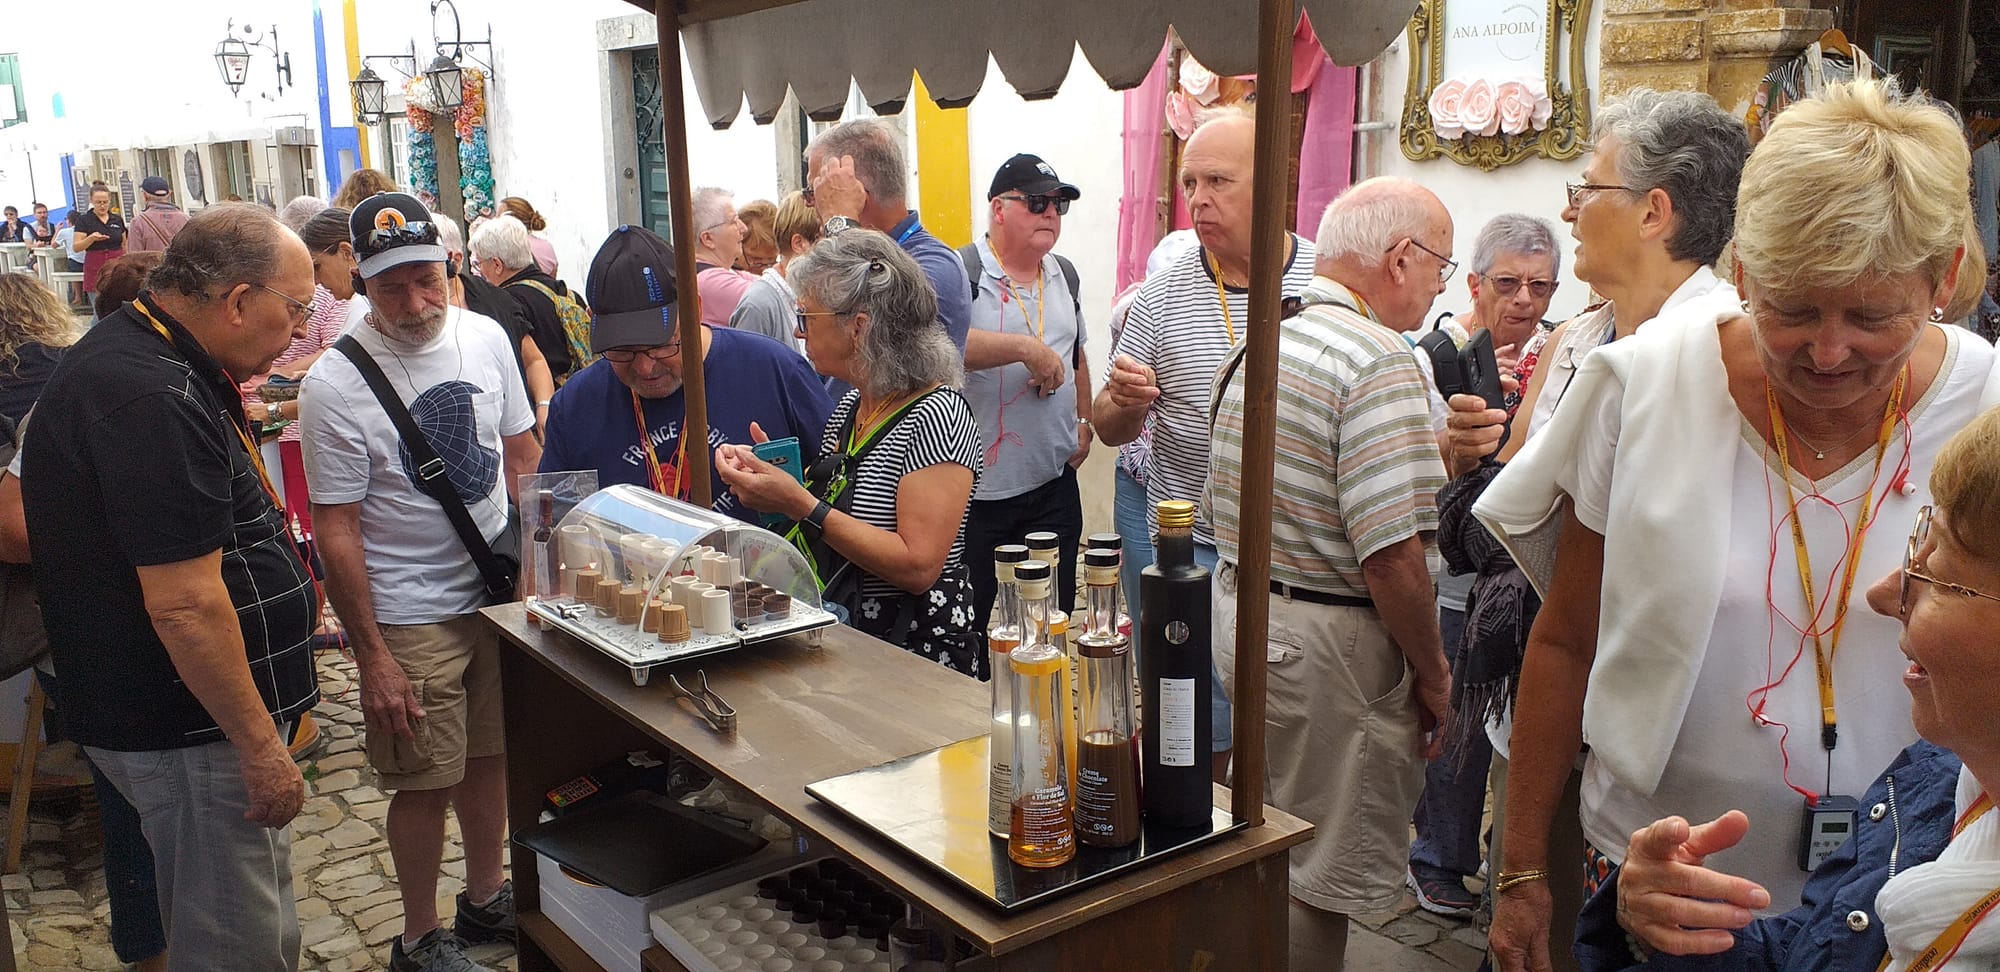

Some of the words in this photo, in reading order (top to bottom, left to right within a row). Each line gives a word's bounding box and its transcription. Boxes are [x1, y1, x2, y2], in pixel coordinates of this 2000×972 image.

[1453, 25, 1479, 39] ANA
[1483, 21, 1535, 37] ALPOIM
[707, 425, 729, 449] BY
